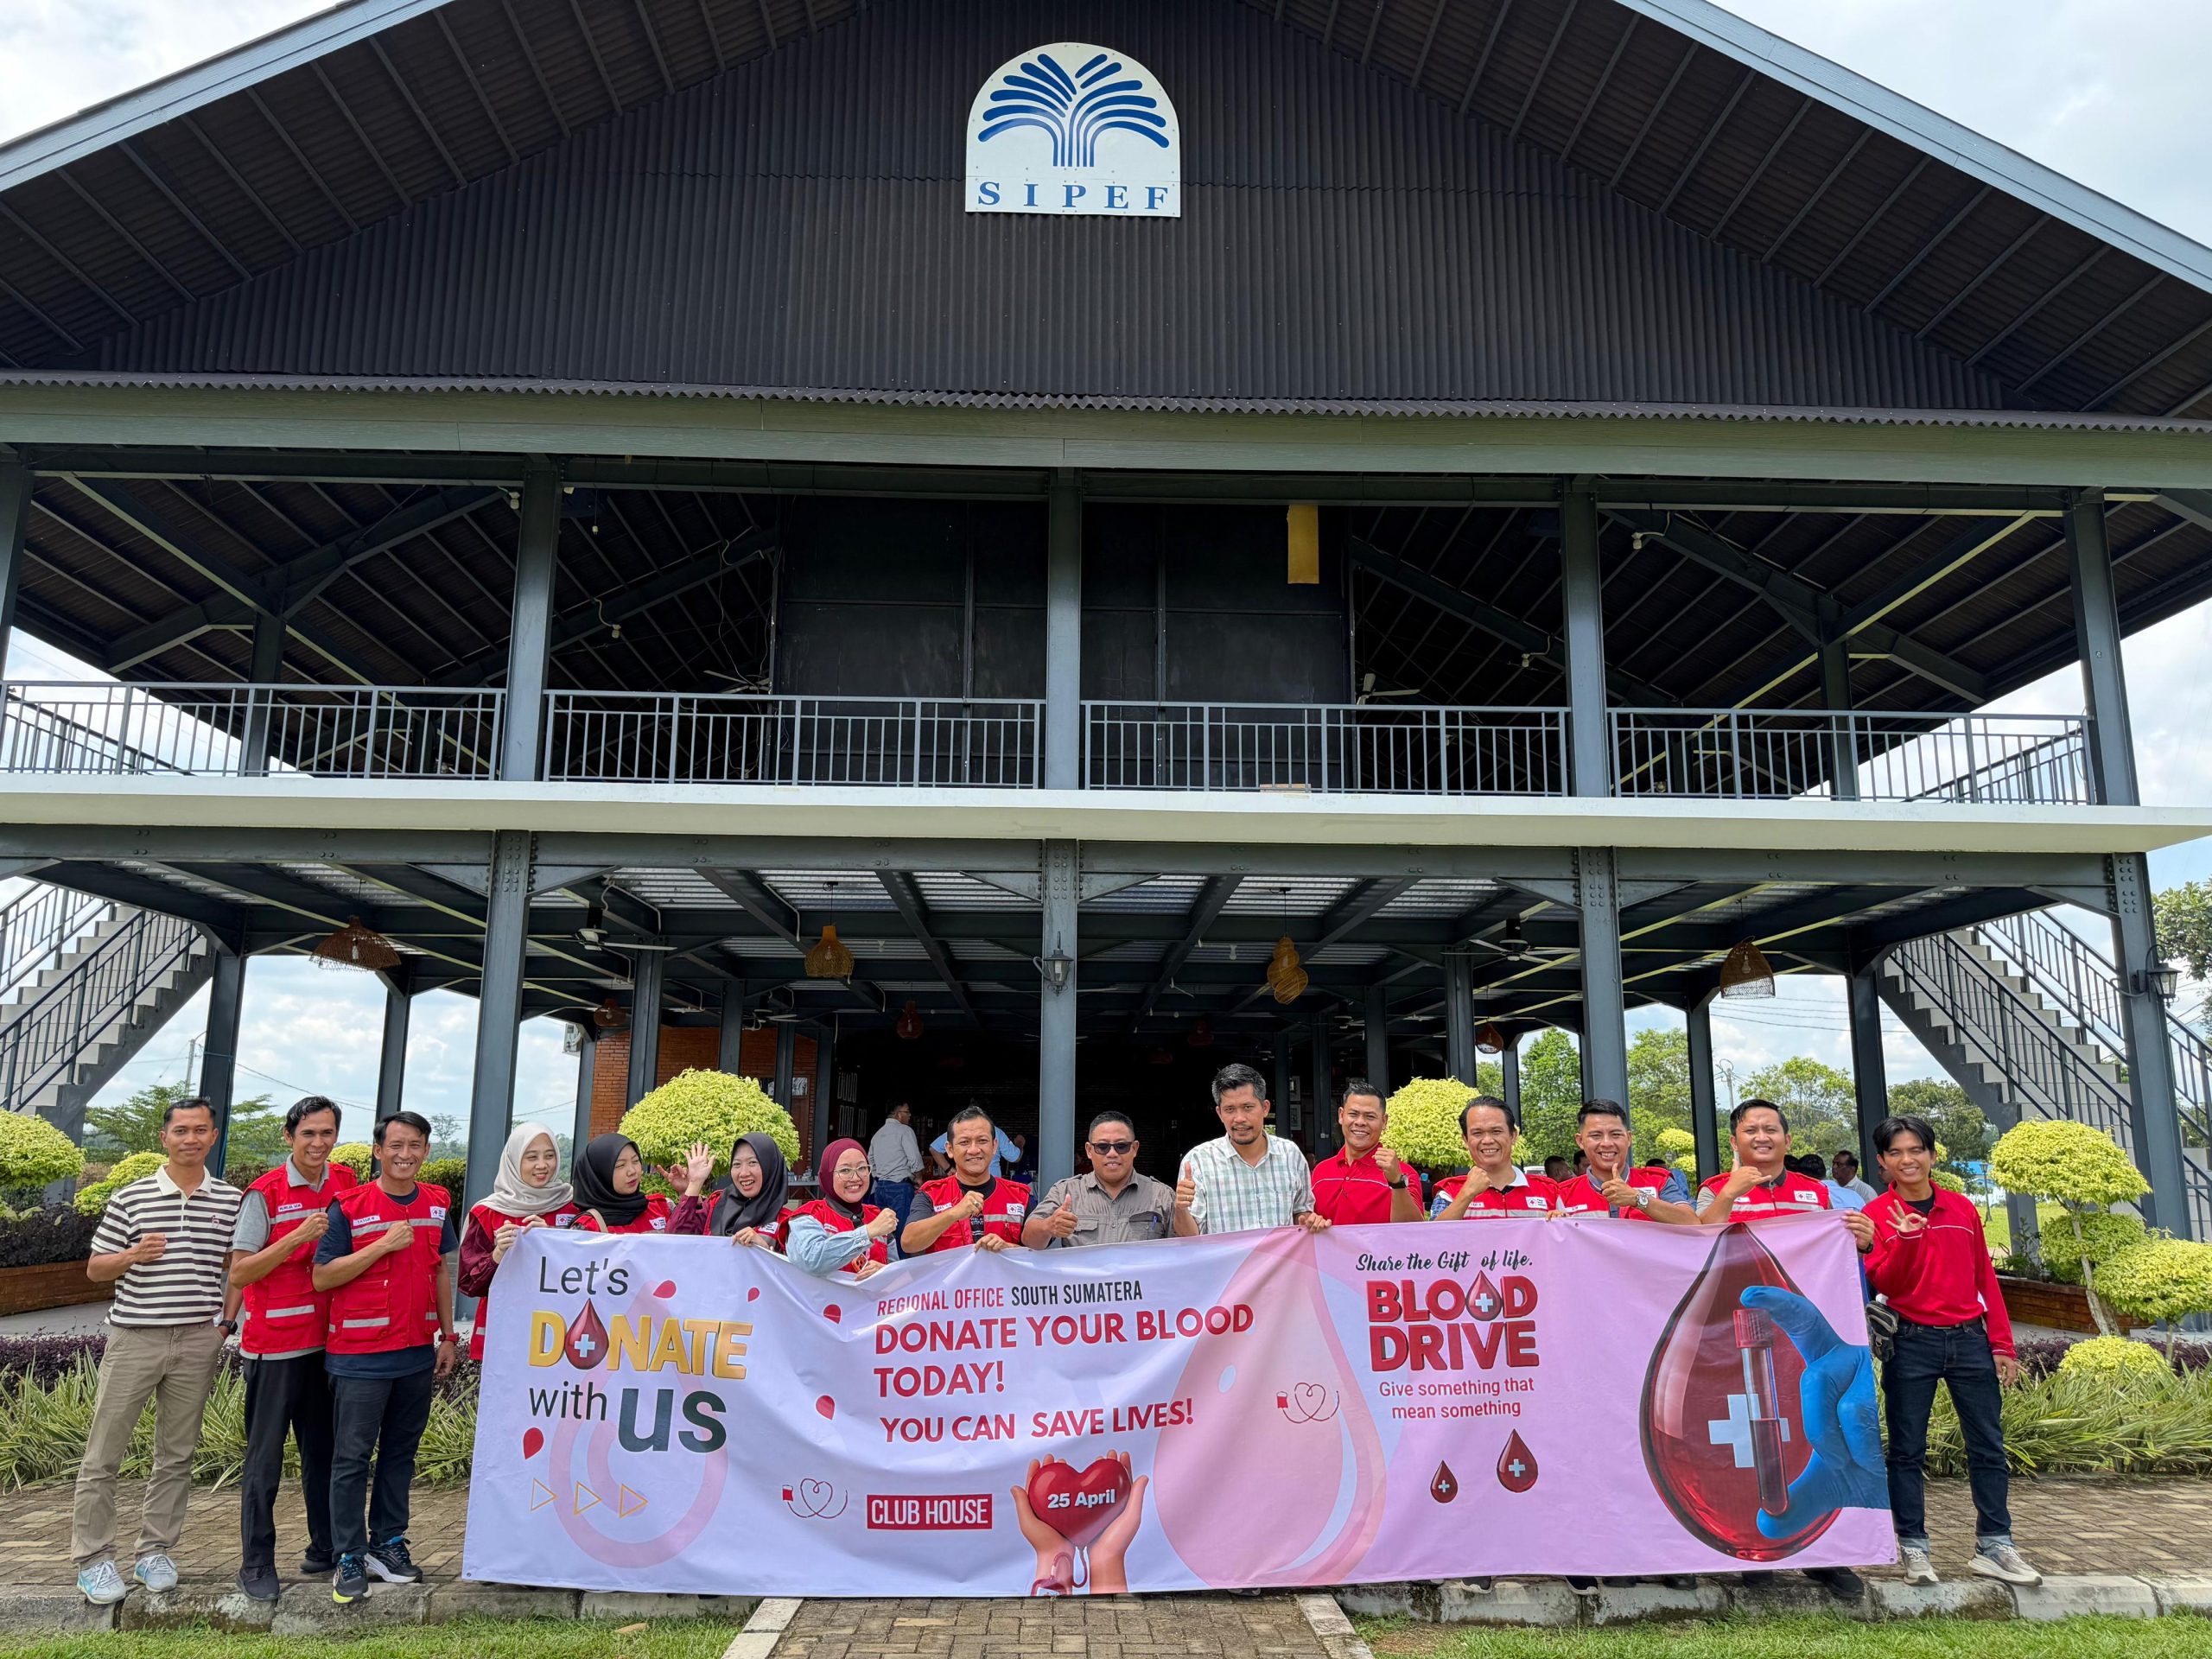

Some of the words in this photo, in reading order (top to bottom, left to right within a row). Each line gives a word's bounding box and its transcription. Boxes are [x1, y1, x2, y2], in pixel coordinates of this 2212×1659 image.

[978, 181, 1168, 210] SIPEF
[539, 1255, 629, 1295] Let's
[1356, 1253, 1404, 1271] Share
[1407, 1253, 1433, 1270] the
[1437, 1251, 1471, 1272] Gift
[1480, 1251, 1499, 1270] of
[1502, 1249, 1533, 1269] life.
[877, 1290, 948, 1316] REGIONAL
[955, 1287, 1004, 1309] OFFICE
[1011, 1285, 1059, 1306] SOUTH
[1064, 1280, 1143, 1304] SUMATERA
[875, 1317, 1017, 1354] DONATE
[1026, 1313, 1127, 1346] YOUR
[1136, 1303, 1255, 1341] BLOOD
[1370, 1320, 1540, 1372] DRIVE
[874, 1360, 1005, 1398] TODAY!
[1379, 1381, 1414, 1397] Give
[1418, 1379, 1501, 1396] something
[1503, 1376, 1535, 1392] that
[529, 1381, 607, 1421] with
[618, 1388, 727, 1452] us
[880, 1416, 944, 1443] YOU
[952, 1414, 1015, 1441] CAN
[1031, 1408, 1104, 1438] SAVE
[1112, 1398, 1194, 1433] LIVES!
[1392, 1406, 1436, 1419] mean
[1440, 1401, 1522, 1419] something
[871, 1498, 920, 1525] CLUB
[925, 1497, 988, 1524] HOUSE
[1047, 1492, 1071, 1509] 25
[1075, 1489, 1116, 1509] April
